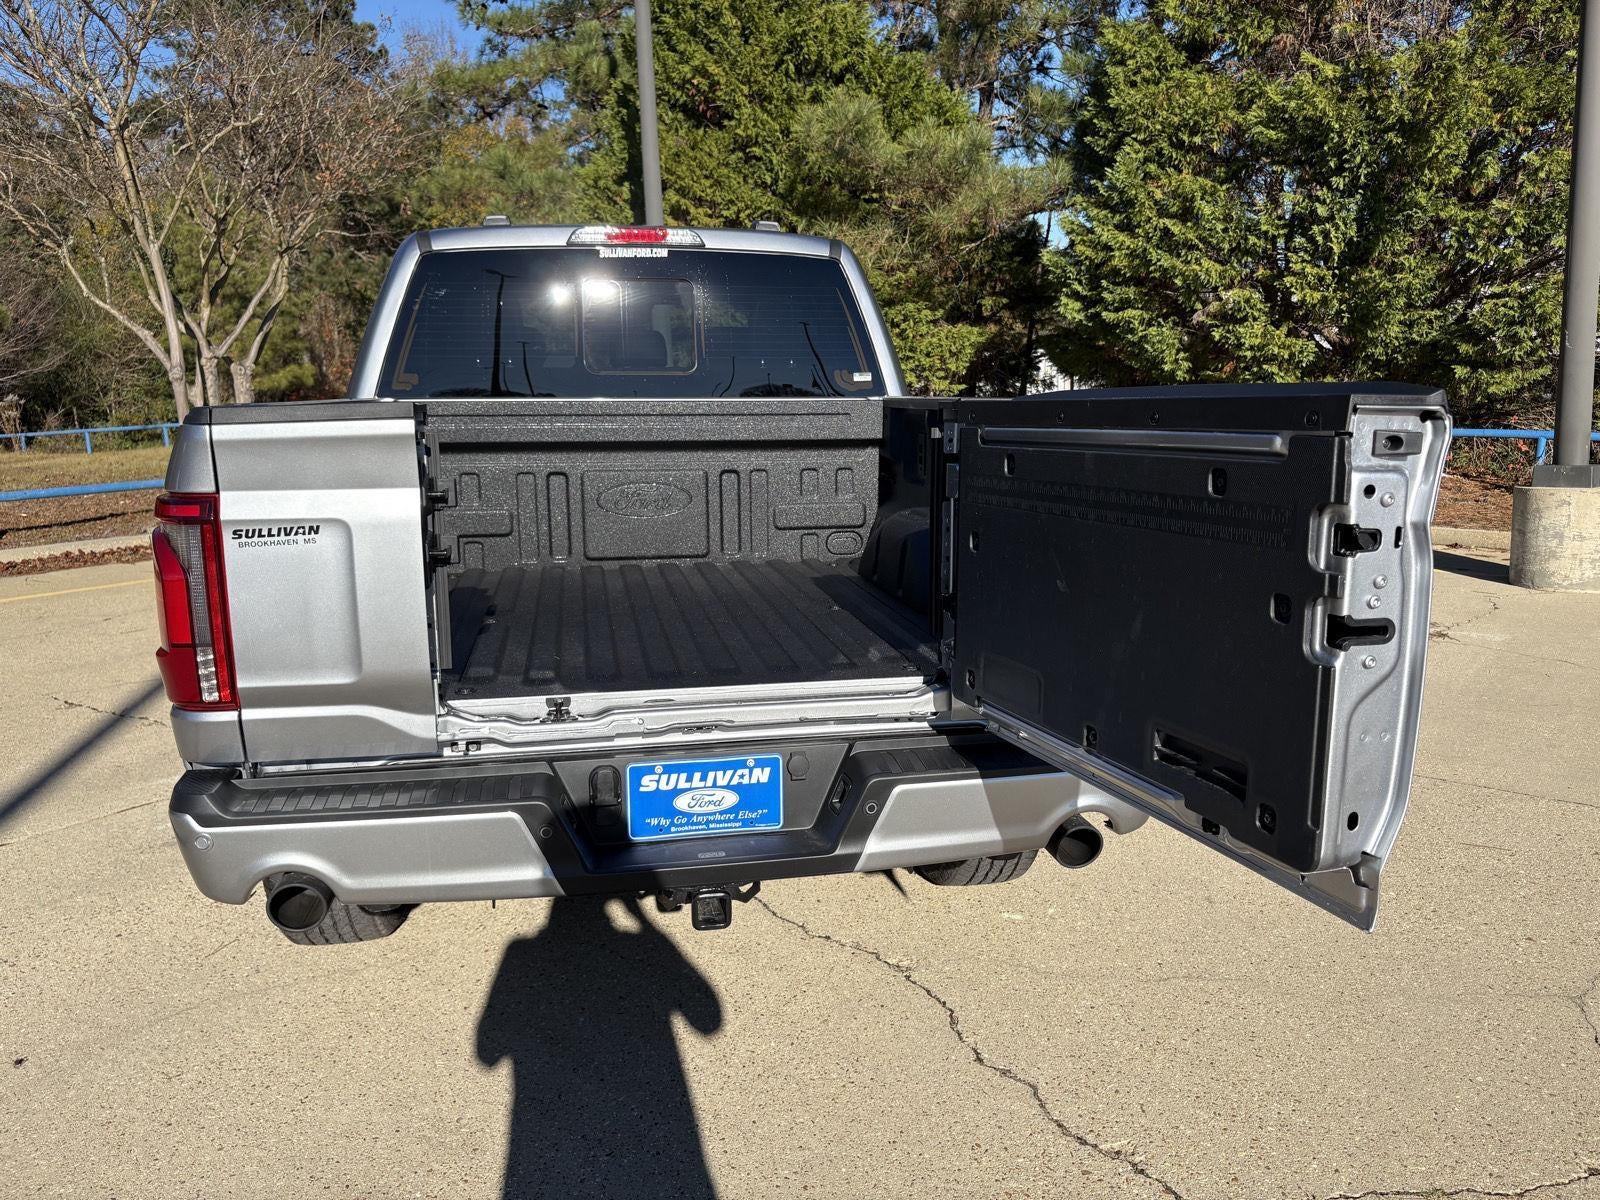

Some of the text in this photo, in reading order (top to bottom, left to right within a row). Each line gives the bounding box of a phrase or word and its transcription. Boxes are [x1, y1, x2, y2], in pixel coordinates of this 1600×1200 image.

[599, 247, 669, 258] SULLIVANFORD.COM
[614, 484, 674, 511] Ford
[231, 525, 321, 539] SULLIVAN
[238, 537, 317, 548] BROOKHAVEN MS
[639, 767, 771, 791] SULLIVAN
[687, 793, 725, 809] Ford
[674, 815, 687, 825] Go
[690, 813, 735, 824] Anywhere
[671, 824, 707, 832] Brookhaven,
